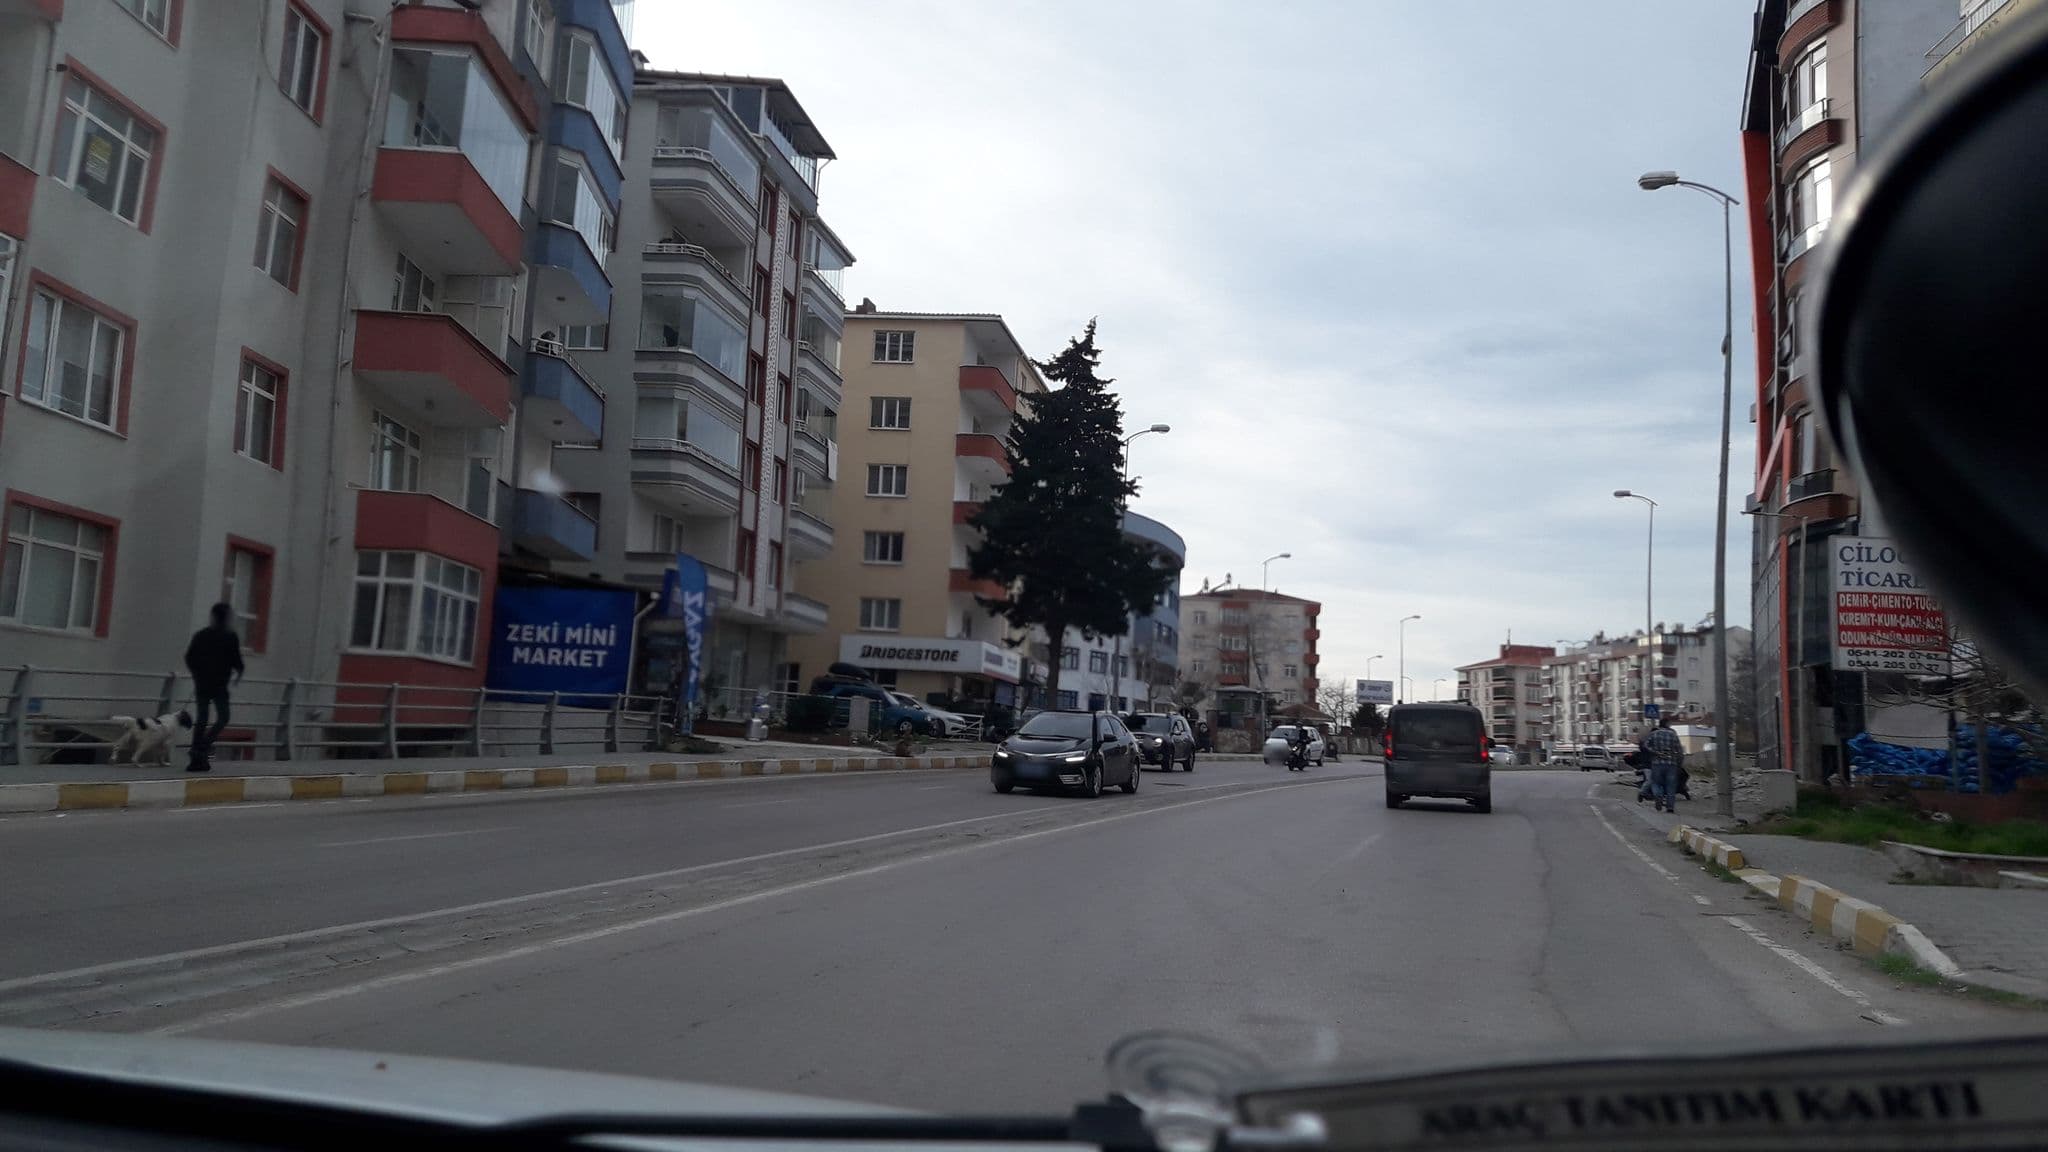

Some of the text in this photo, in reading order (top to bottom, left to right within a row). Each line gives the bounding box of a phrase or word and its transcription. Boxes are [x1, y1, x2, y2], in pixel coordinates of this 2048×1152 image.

[506, 621, 617, 646] ZEKİ MİNİ
[511, 646, 608, 668] MARKET
[859, 644, 960, 662] BRIDGESTONE
[1421, 1080, 1983, 1140] ARAÇ TANITIM KARTI
